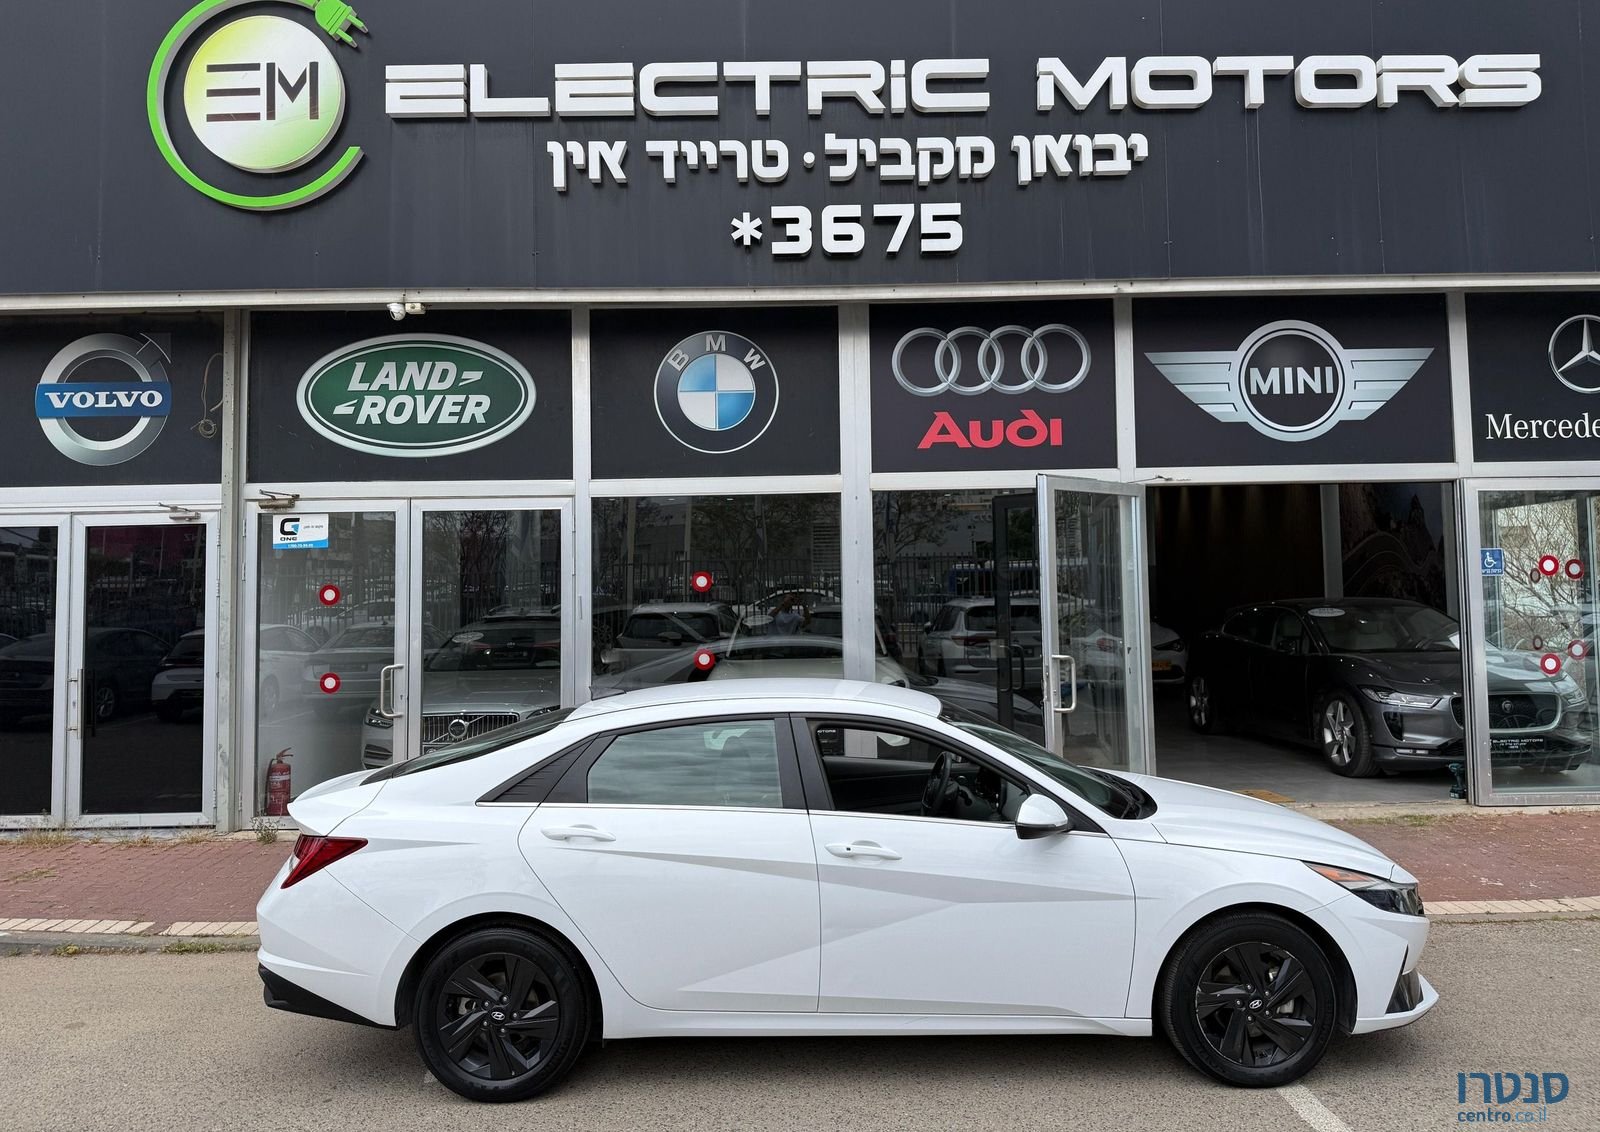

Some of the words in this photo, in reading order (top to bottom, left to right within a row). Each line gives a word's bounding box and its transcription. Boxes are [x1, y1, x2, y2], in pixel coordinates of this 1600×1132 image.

[207, 62, 318, 121] EM
[1036, 53, 1542, 111] MOTORS
[546, 140, 628, 192] אין
[646, 139, 790, 183] טרייד
[824, 132, 995, 186] מקביל
[1010, 132, 1149, 186] יבואן
[666, 334, 766, 372] BMW
[347, 360, 457, 392] LAND
[1249, 365, 1335, 396] MINI
[44, 390, 163, 409] VOLVO
[355, 394, 492, 426] ROVER
[917, 408, 1063, 449] Audi
